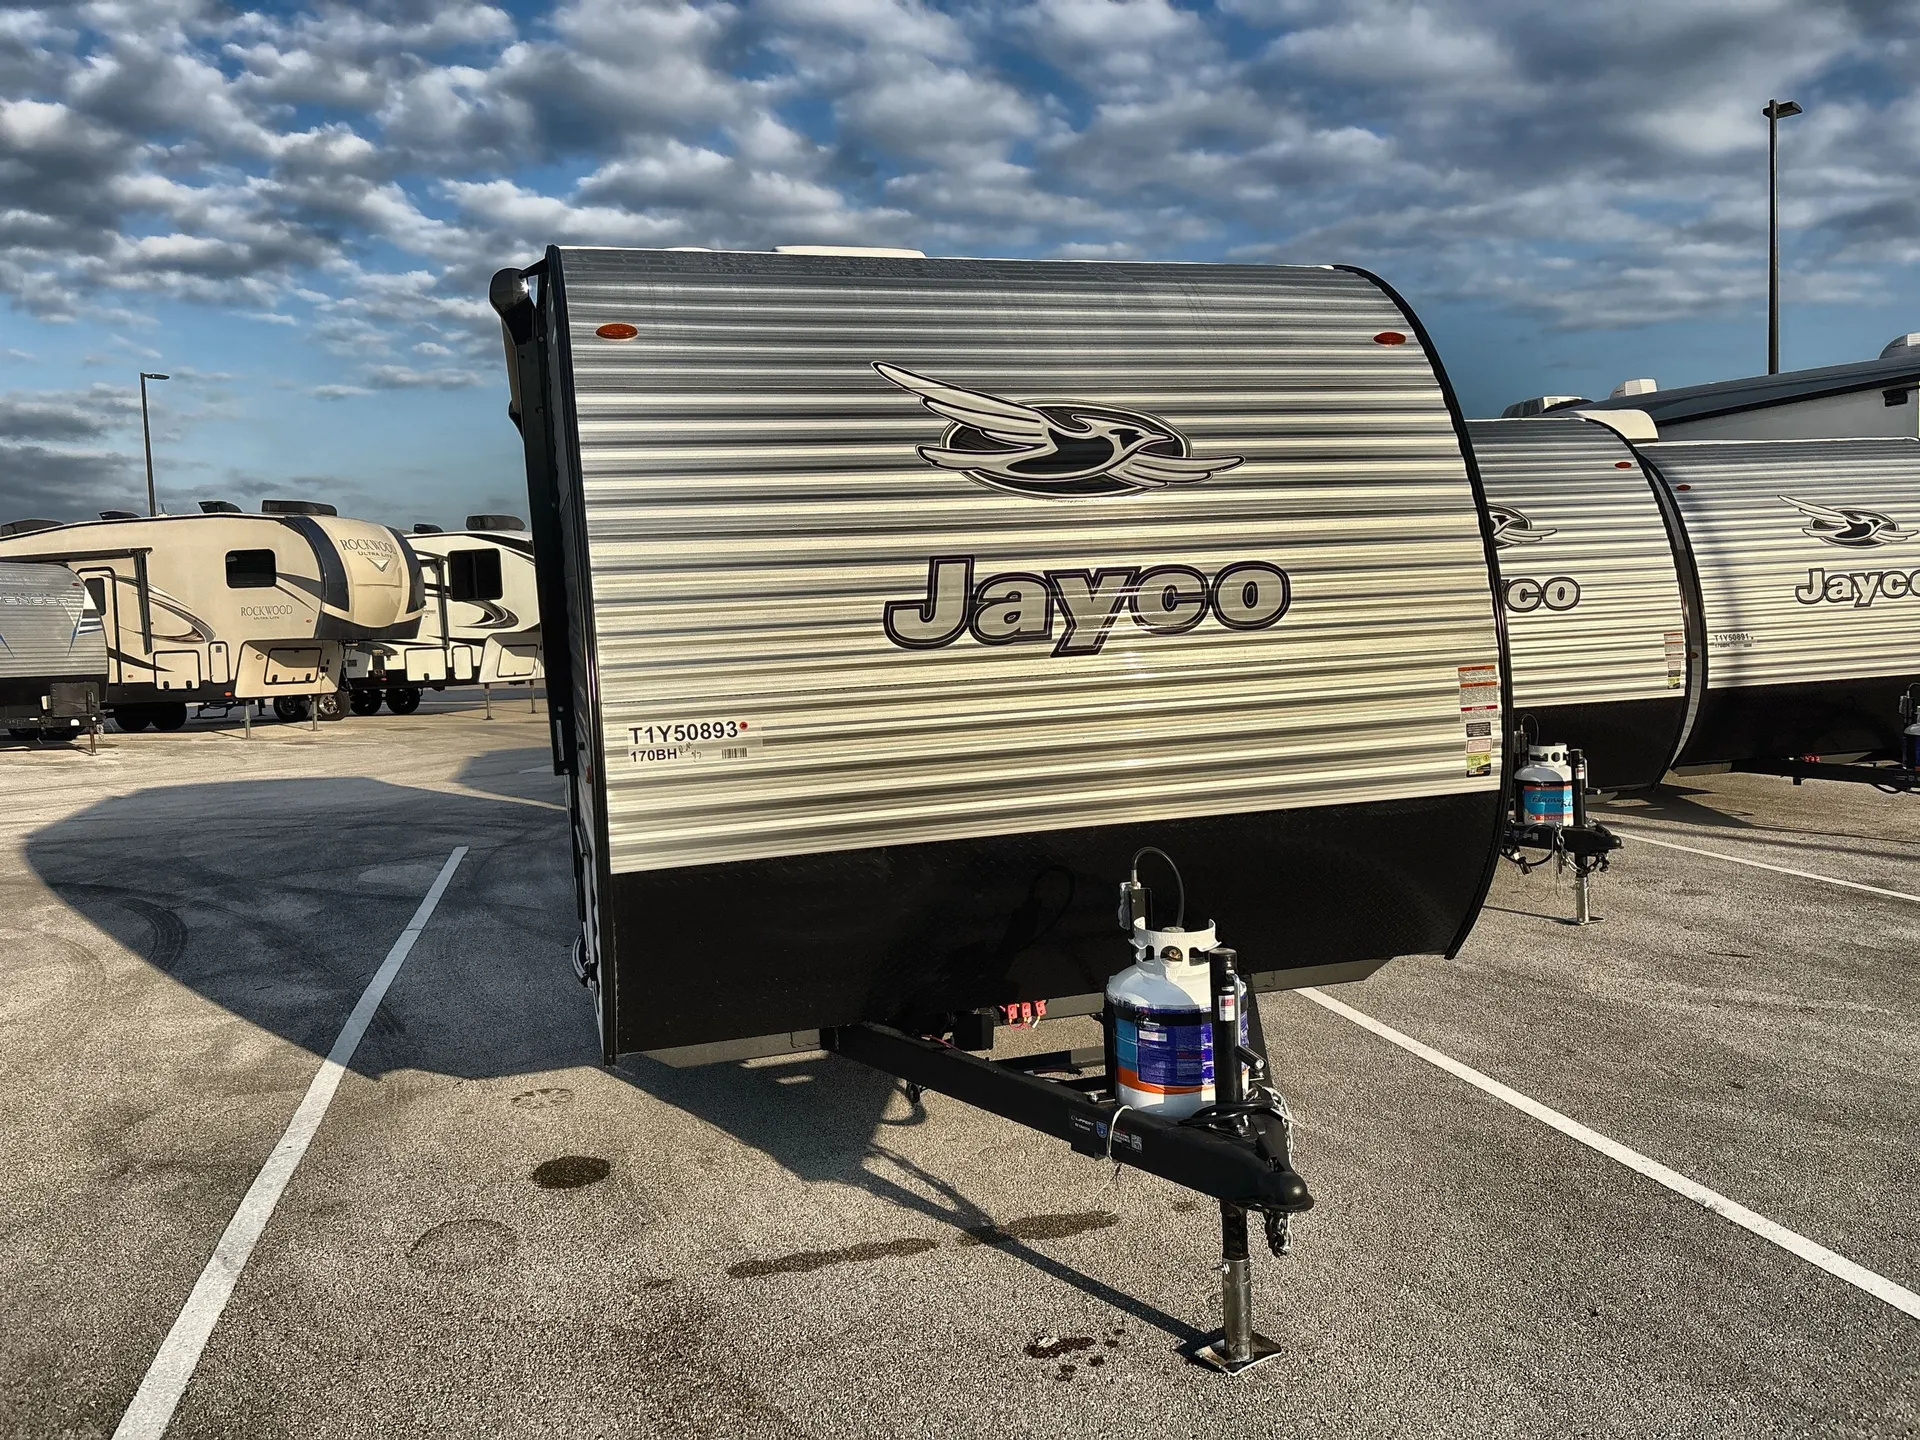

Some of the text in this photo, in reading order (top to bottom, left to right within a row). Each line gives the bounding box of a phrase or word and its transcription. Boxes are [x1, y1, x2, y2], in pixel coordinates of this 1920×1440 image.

[340, 538, 397, 555] ROCKWOOD
[0, 596, 70, 606] ENGER
[882, 554, 1292, 658] Jayco
[240, 604, 293, 617] ROCKWOOD
[628, 720, 738, 745] T1Y50893
[630, 747, 677, 763] 170BH
